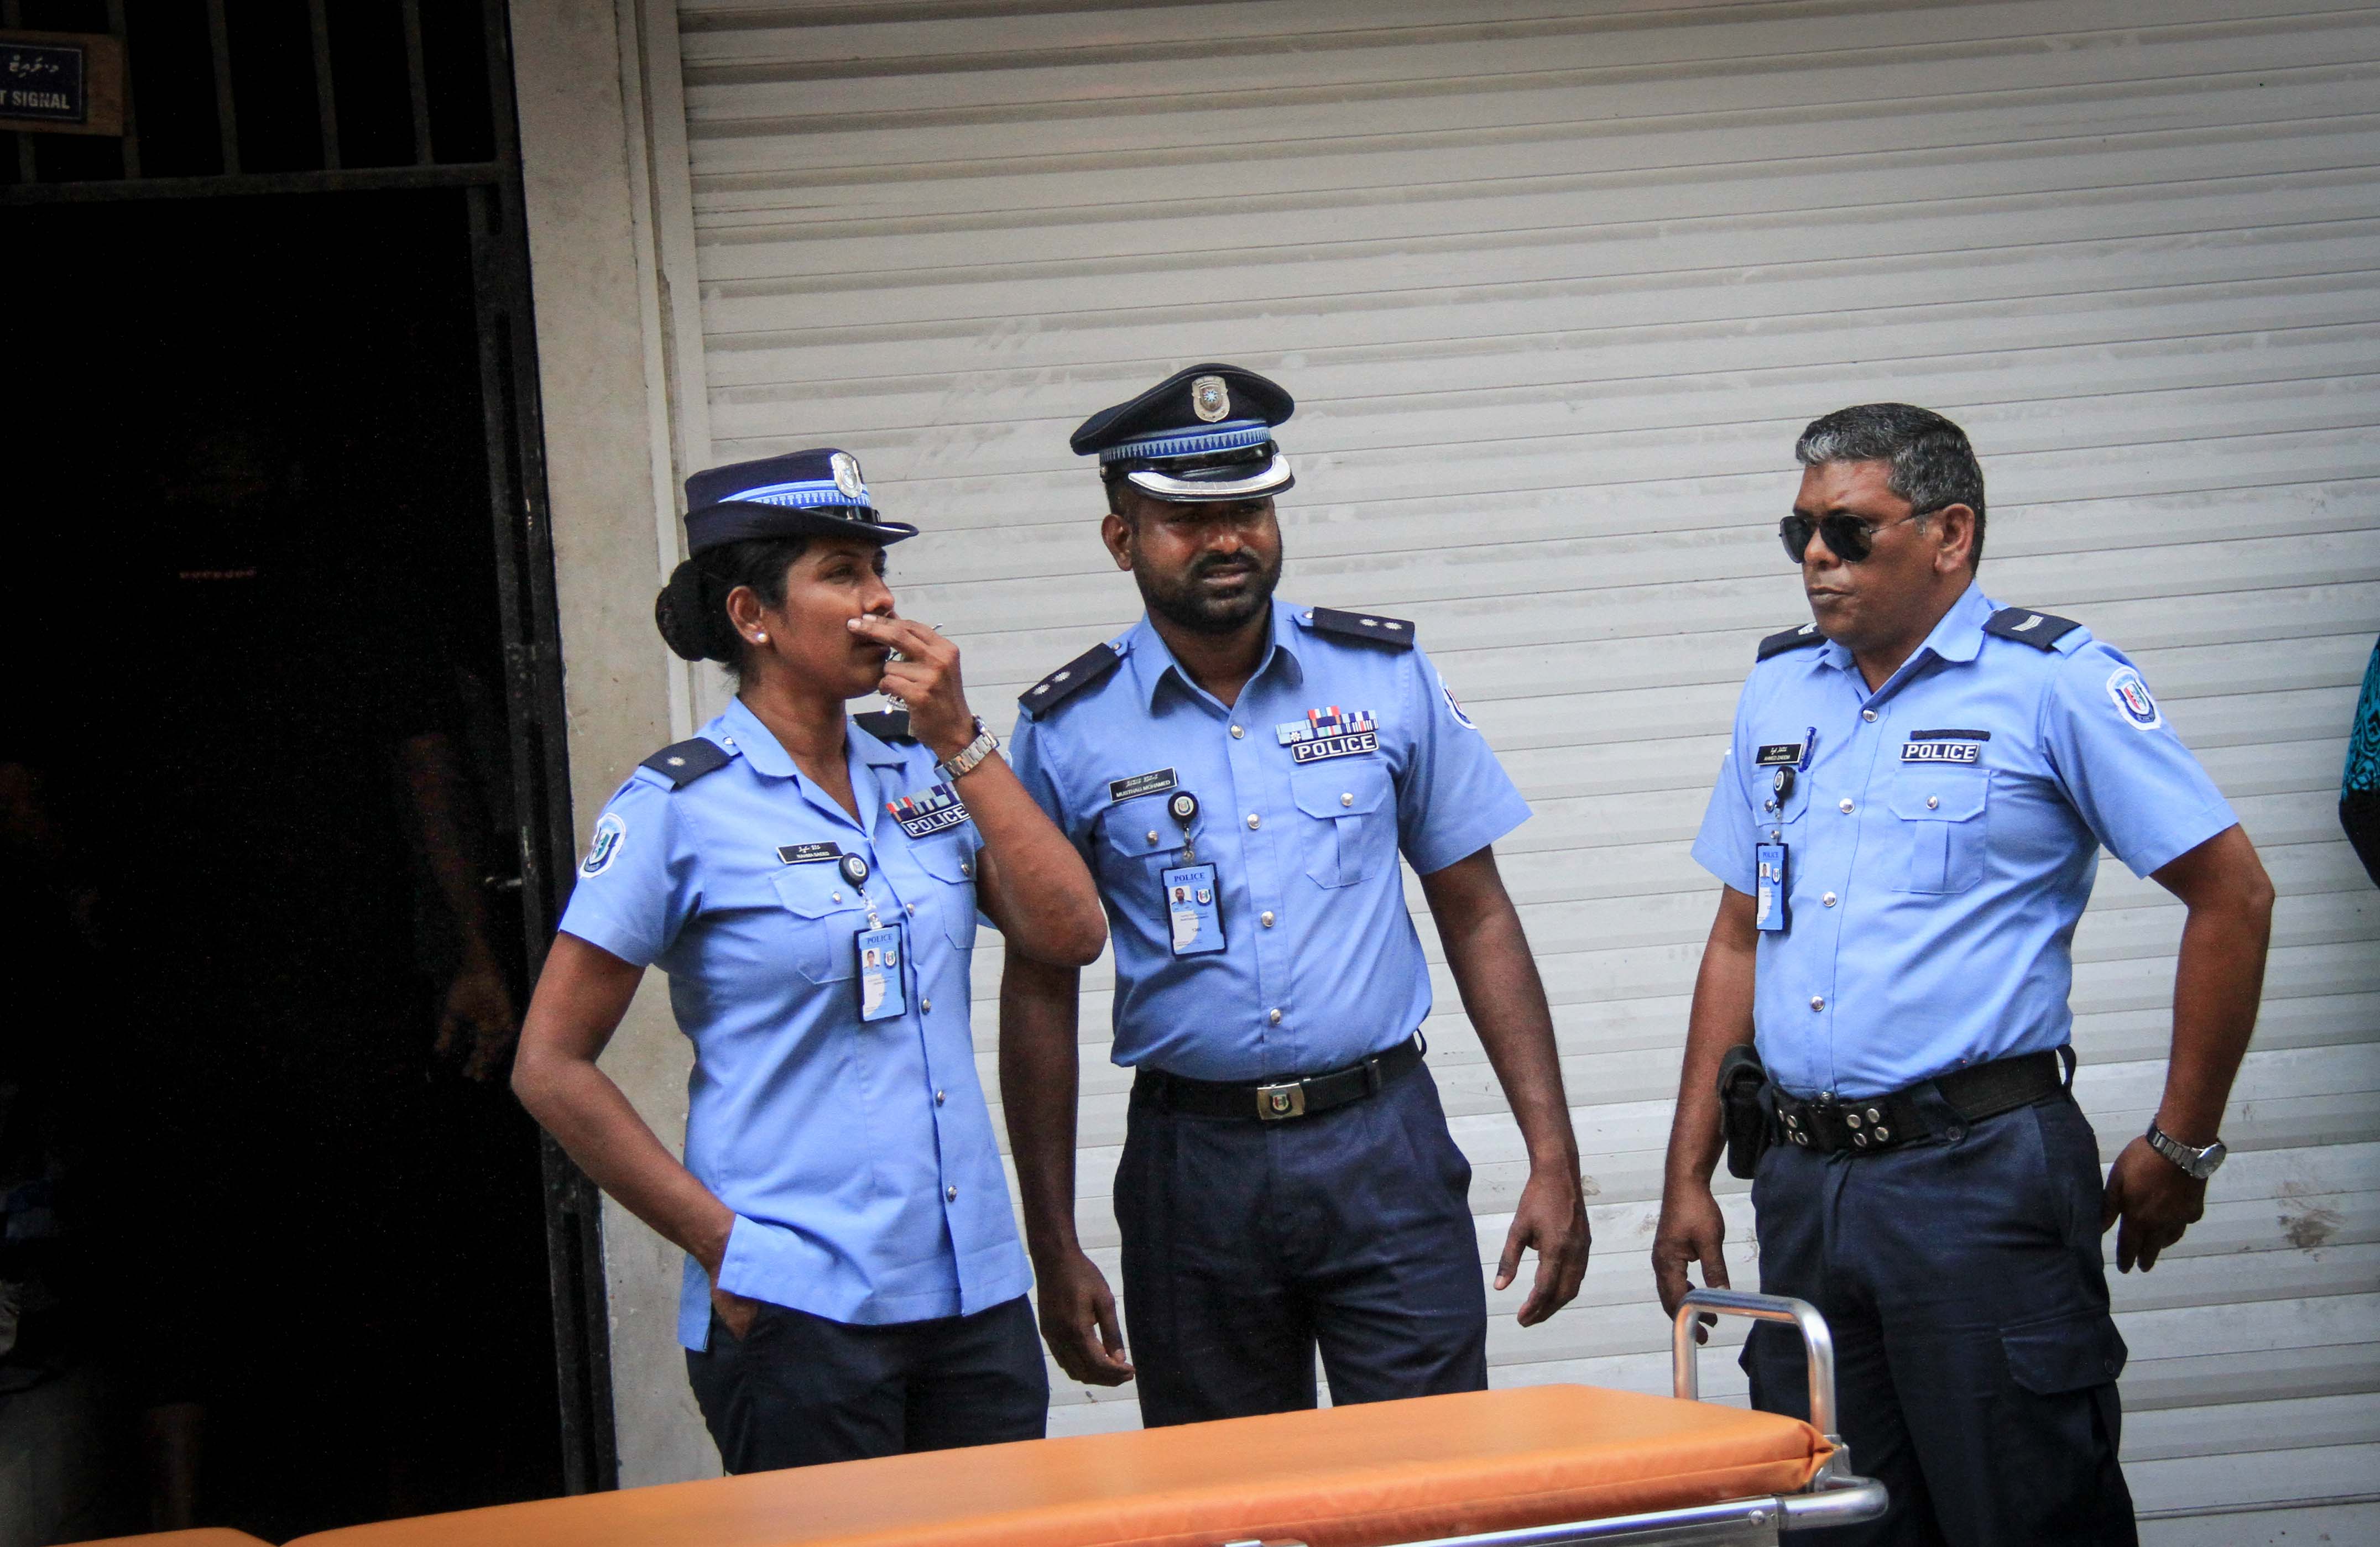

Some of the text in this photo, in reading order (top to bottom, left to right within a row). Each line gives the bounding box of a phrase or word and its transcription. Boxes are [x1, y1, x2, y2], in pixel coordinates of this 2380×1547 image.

[12, 90, 71, 109] SIGNAL
[1297, 734, 1376, 759] POLICE
[1905, 745, 1976, 759] POLICE
[906, 806, 969, 834] POLICE
[1174, 872, 1205, 882] POLICE
[867, 933, 893, 944] POLICE
